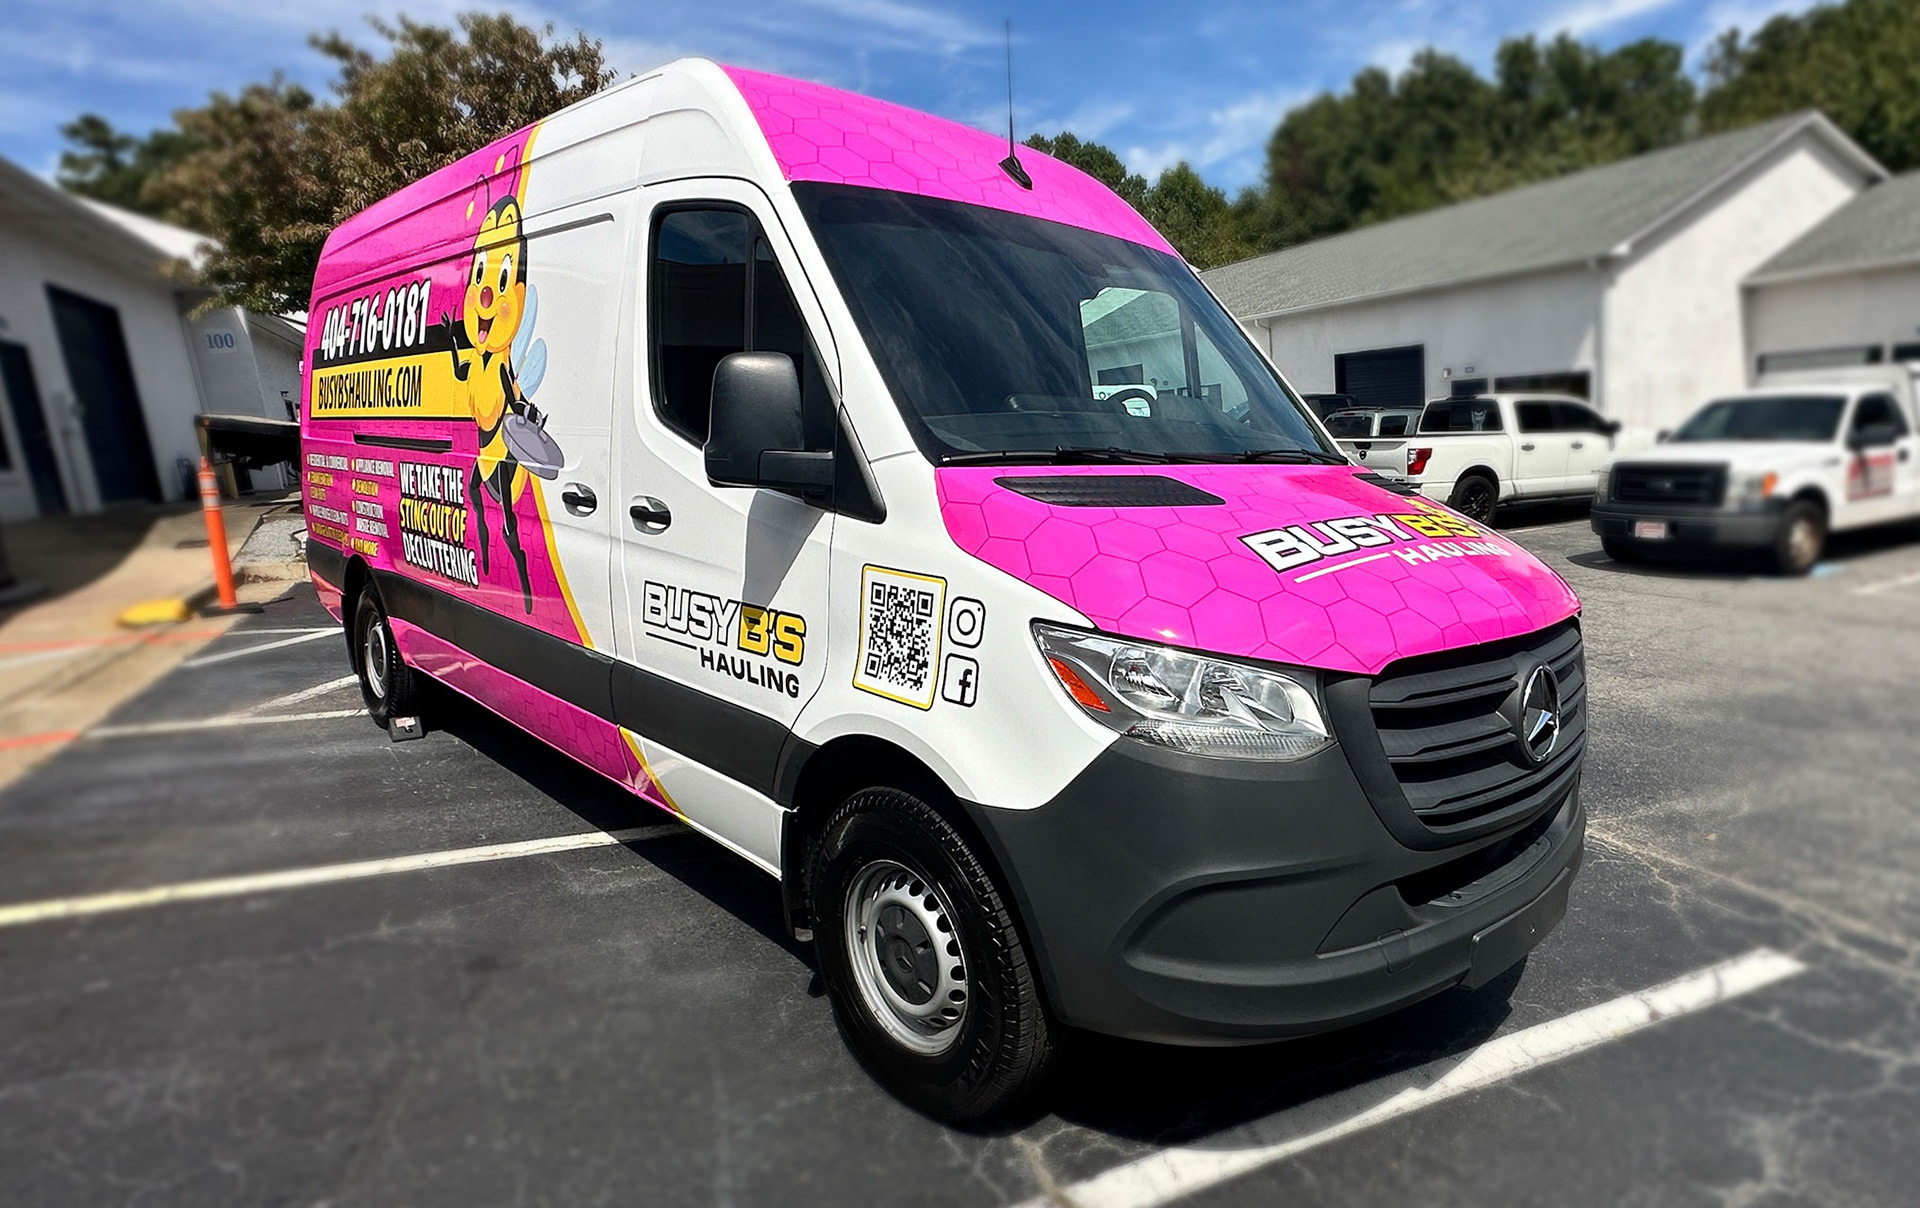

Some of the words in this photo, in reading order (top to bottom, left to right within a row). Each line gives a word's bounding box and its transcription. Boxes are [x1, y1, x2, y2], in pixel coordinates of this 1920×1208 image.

[206, 333, 234, 349] 100
[321, 278, 431, 361] 404-716-0181
[318, 364, 422, 410] BUSYBSHAULING.COM
[400, 462, 415, 495] WE
[415, 463, 442, 500] TAKE
[442, 466, 464, 504] THE
[400, 497, 428, 534] STING
[428, 502, 452, 540] OUT
[452, 507, 467, 544] OF
[402, 531, 479, 586] DECLUTTERING
[1391, 540, 1512, 566] HAULING
[700, 647, 800, 698] HAULING
